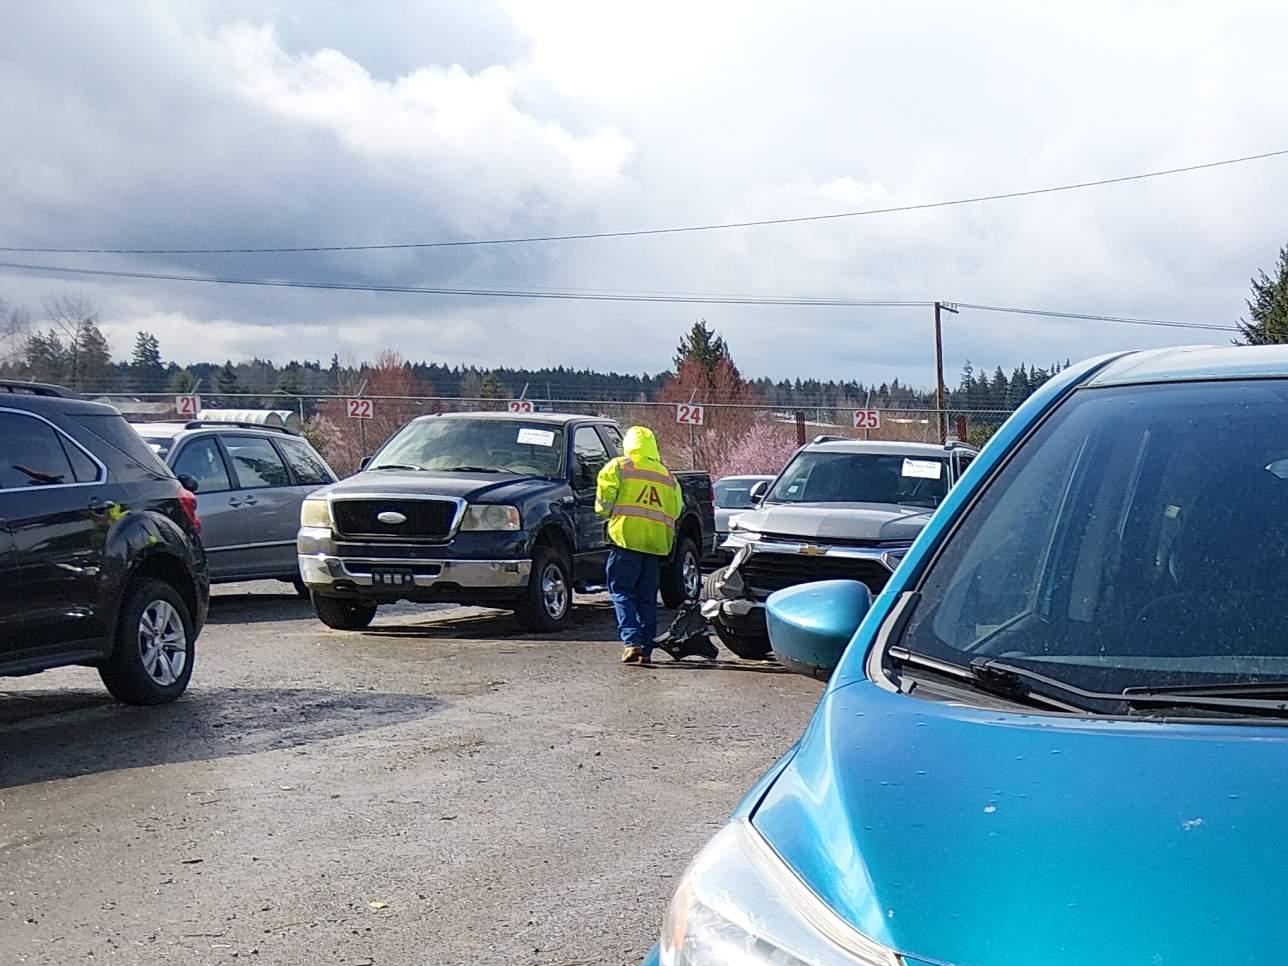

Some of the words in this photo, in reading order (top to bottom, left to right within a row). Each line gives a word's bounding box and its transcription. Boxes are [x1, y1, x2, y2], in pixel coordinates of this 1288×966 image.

[180, 397, 197, 412] 21
[350, 400, 371, 417] 22
[679, 406, 701, 423] 24
[855, 411, 878, 427] 25
